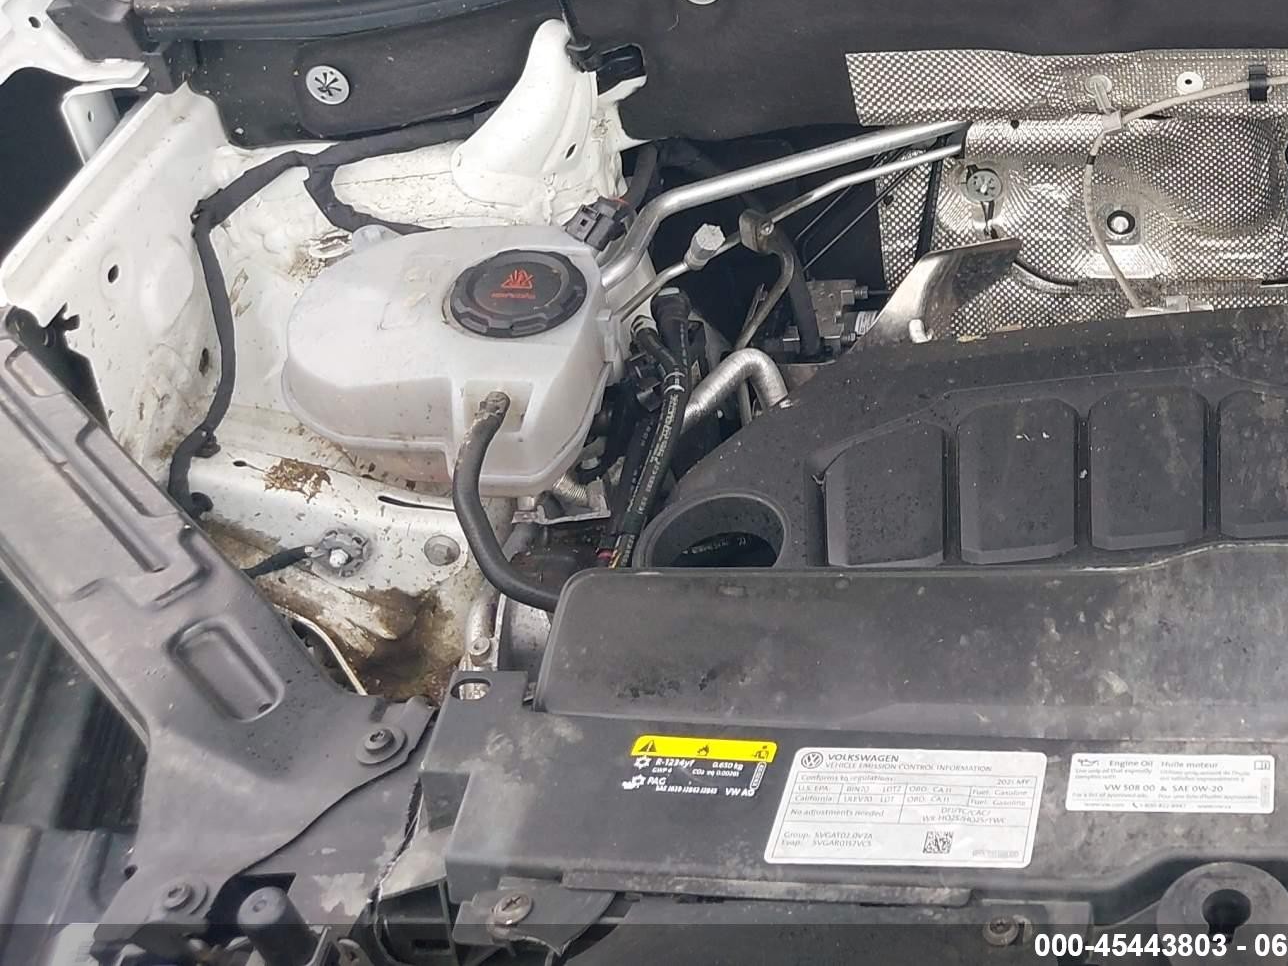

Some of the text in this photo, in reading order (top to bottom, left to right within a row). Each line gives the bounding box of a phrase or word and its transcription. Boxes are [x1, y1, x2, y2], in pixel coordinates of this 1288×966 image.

[828, 753, 899, 762] VOLKSWAGEN
[898, 763, 934, 771] CONTROL
[936, 764, 992, 772] INFORMATION
[1109, 760, 1139, 768] Engine
[647, 776, 667, 785] PAG
[801, 774, 838, 782] Conforms
[725, 787, 741, 796] VW
[804, 809, 853, 817] adjustments
